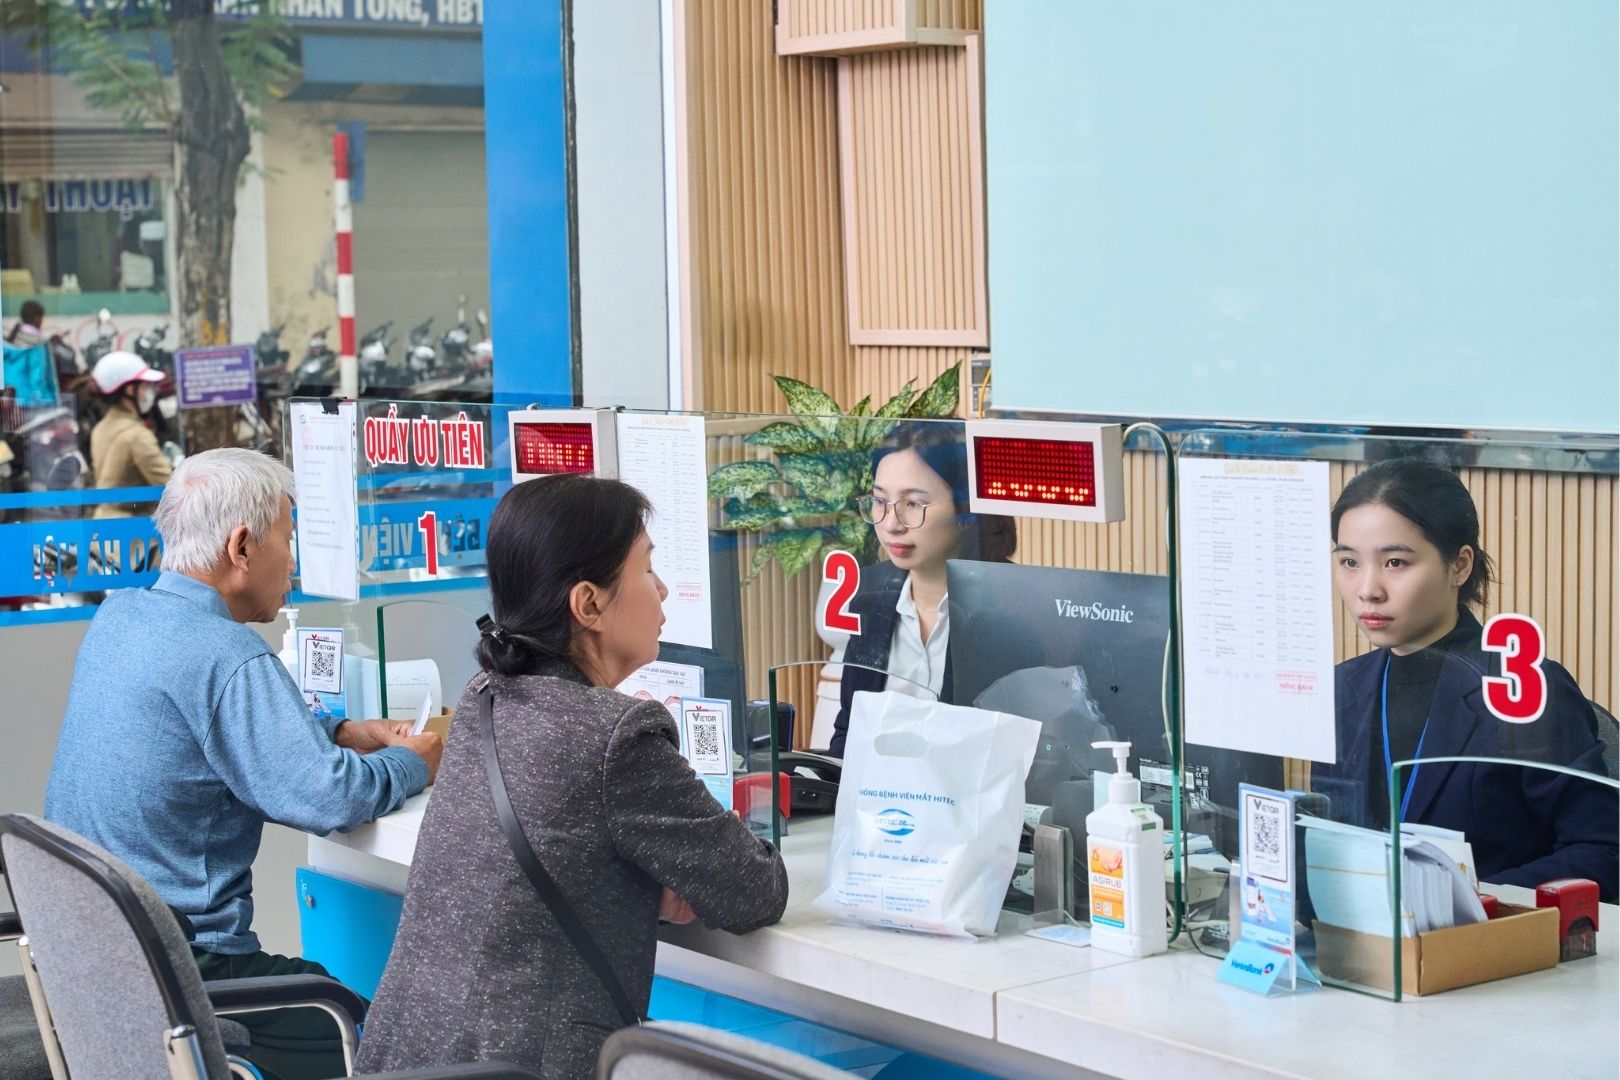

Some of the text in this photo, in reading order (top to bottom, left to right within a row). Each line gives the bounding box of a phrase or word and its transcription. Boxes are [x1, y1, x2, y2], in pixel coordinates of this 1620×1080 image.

[364, 403, 410, 467] QUẦY
[412, 415, 438, 466] ƯU
[440, 411, 485, 469] TIÊN
[418, 510, 438, 579] 1
[823, 550, 861, 635] 2
[1055, 598, 1133, 624] ViewSonic
[1480, 613, 1547, 724] 3
[1093, 875, 1122, 889] ASIRUB
